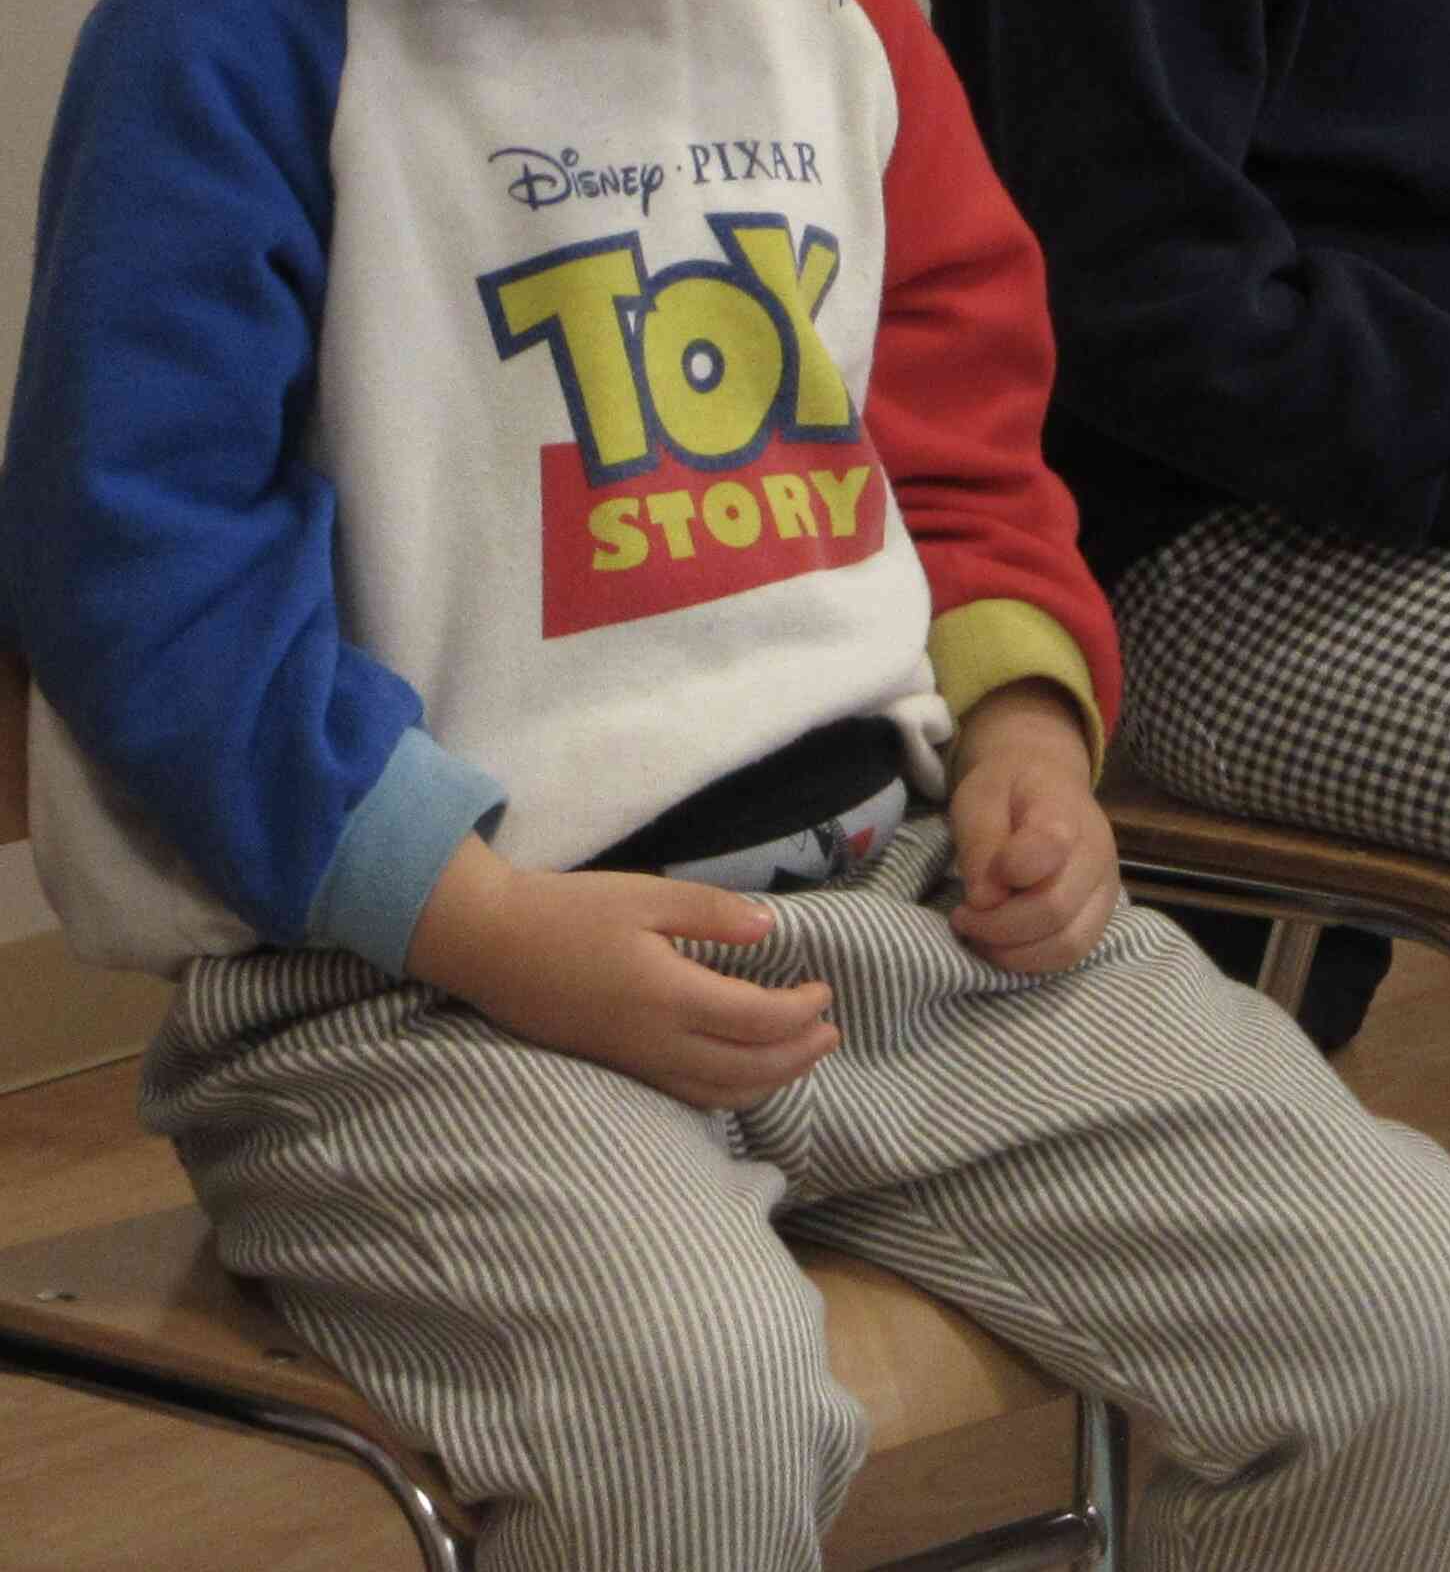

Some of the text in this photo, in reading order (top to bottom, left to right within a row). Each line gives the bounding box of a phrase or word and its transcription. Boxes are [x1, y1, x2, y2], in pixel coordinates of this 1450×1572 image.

[688, 139, 823, 186] PIXAR
[476, 212, 862, 490] TOY
[588, 466, 872, 571] STORY
